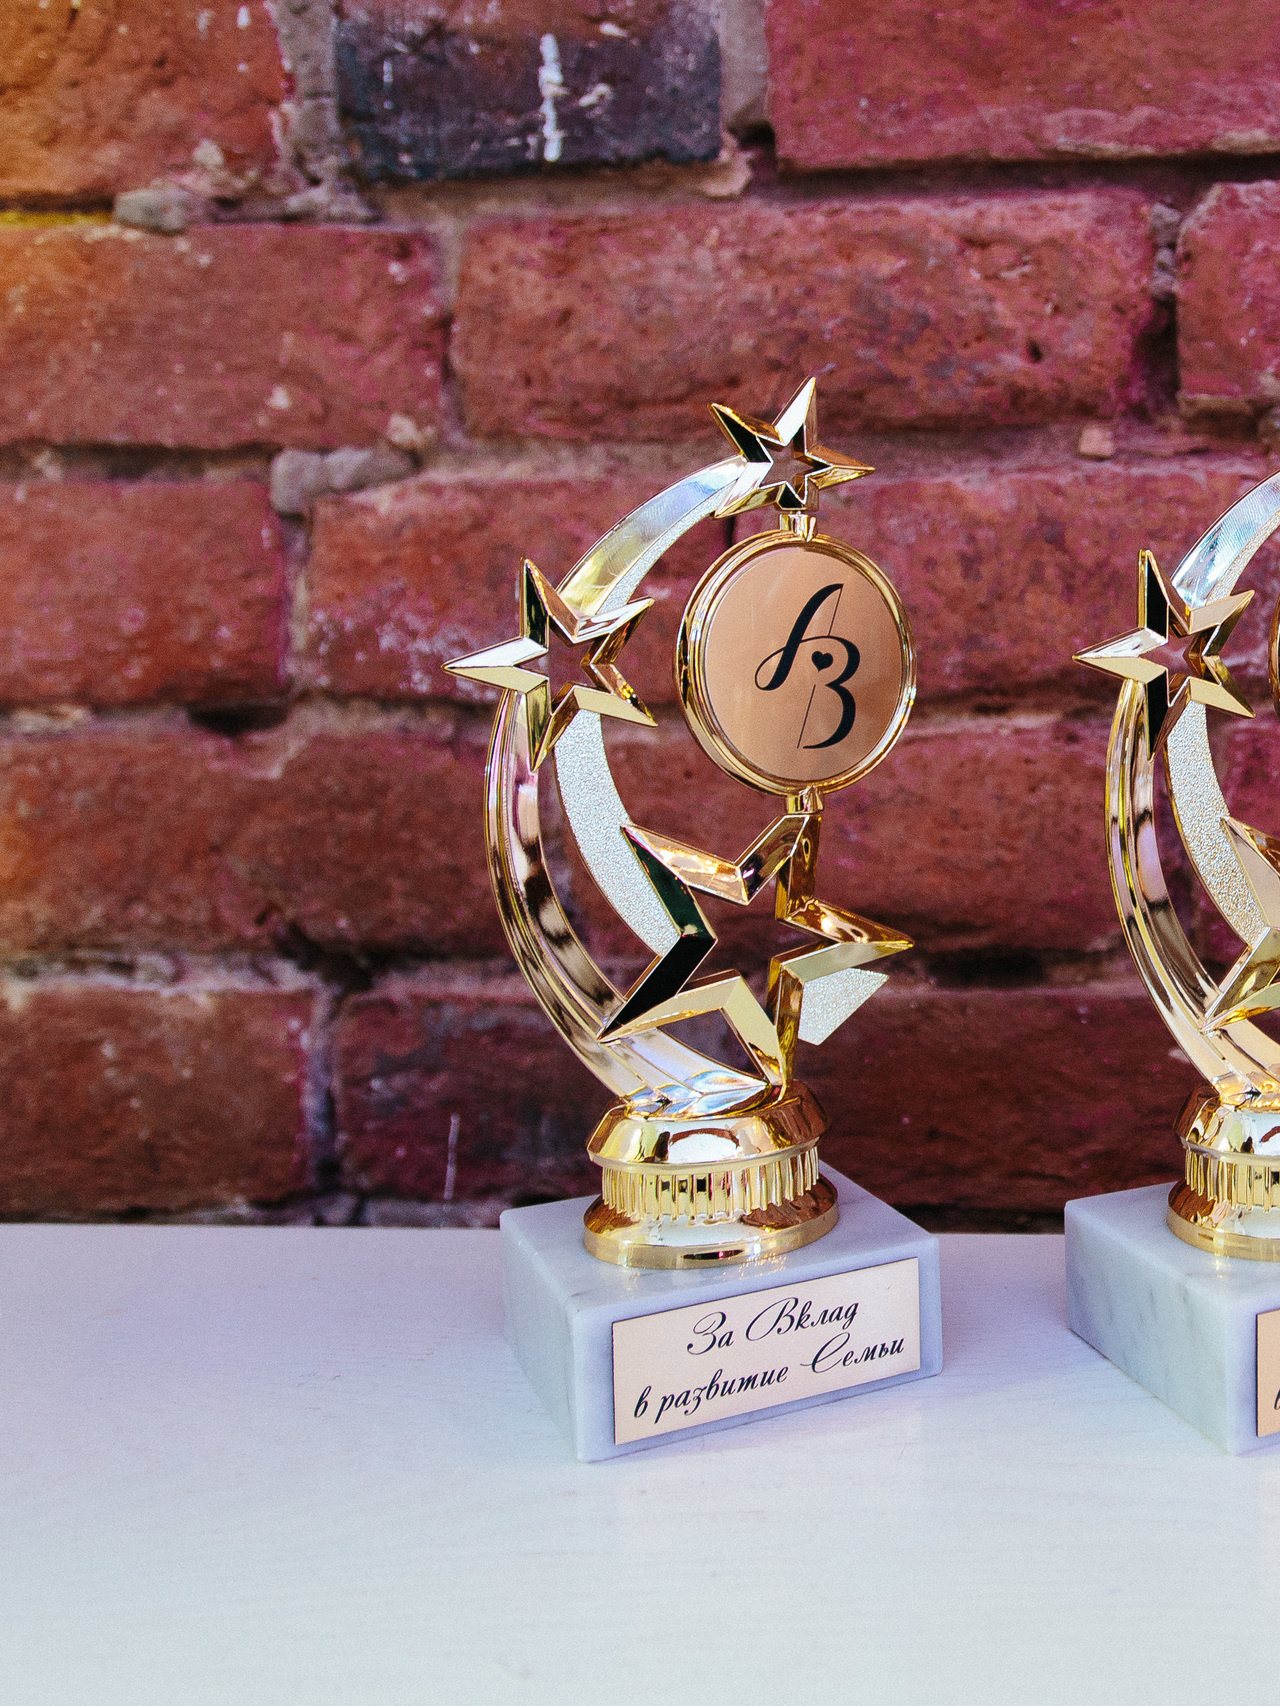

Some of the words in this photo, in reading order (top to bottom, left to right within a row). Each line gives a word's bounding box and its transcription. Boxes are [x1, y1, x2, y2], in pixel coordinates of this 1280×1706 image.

[686, 1311, 734, 1355] За
[745, 1296, 860, 1341] Вклад
[633, 1386, 652, 1418] в
[654, 1366, 789, 1424] развитие
[799, 1332, 905, 1374] Семьи
